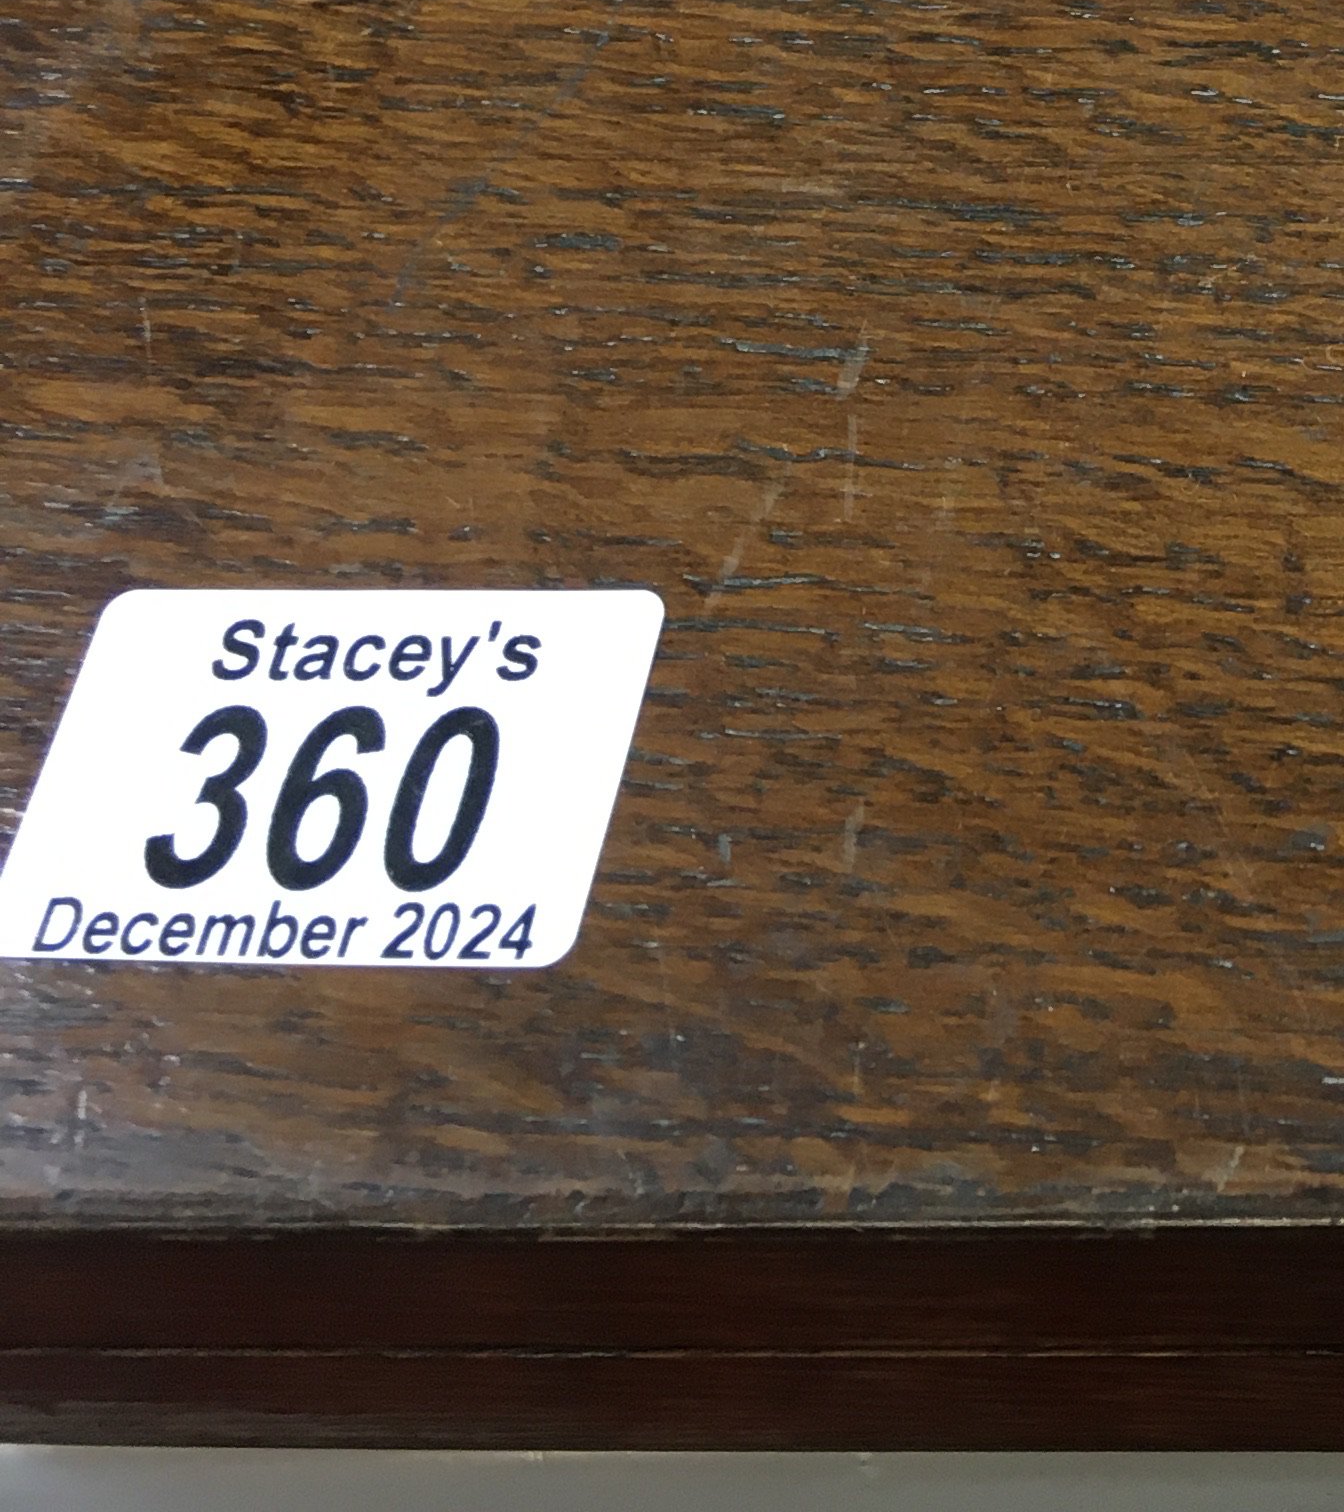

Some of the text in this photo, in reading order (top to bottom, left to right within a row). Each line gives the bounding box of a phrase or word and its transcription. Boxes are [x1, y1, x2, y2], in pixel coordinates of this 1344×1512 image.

[212, 619, 541, 697] Stacey's
[145, 705, 499, 892] 360
[33, 897, 537, 960] December 2024
